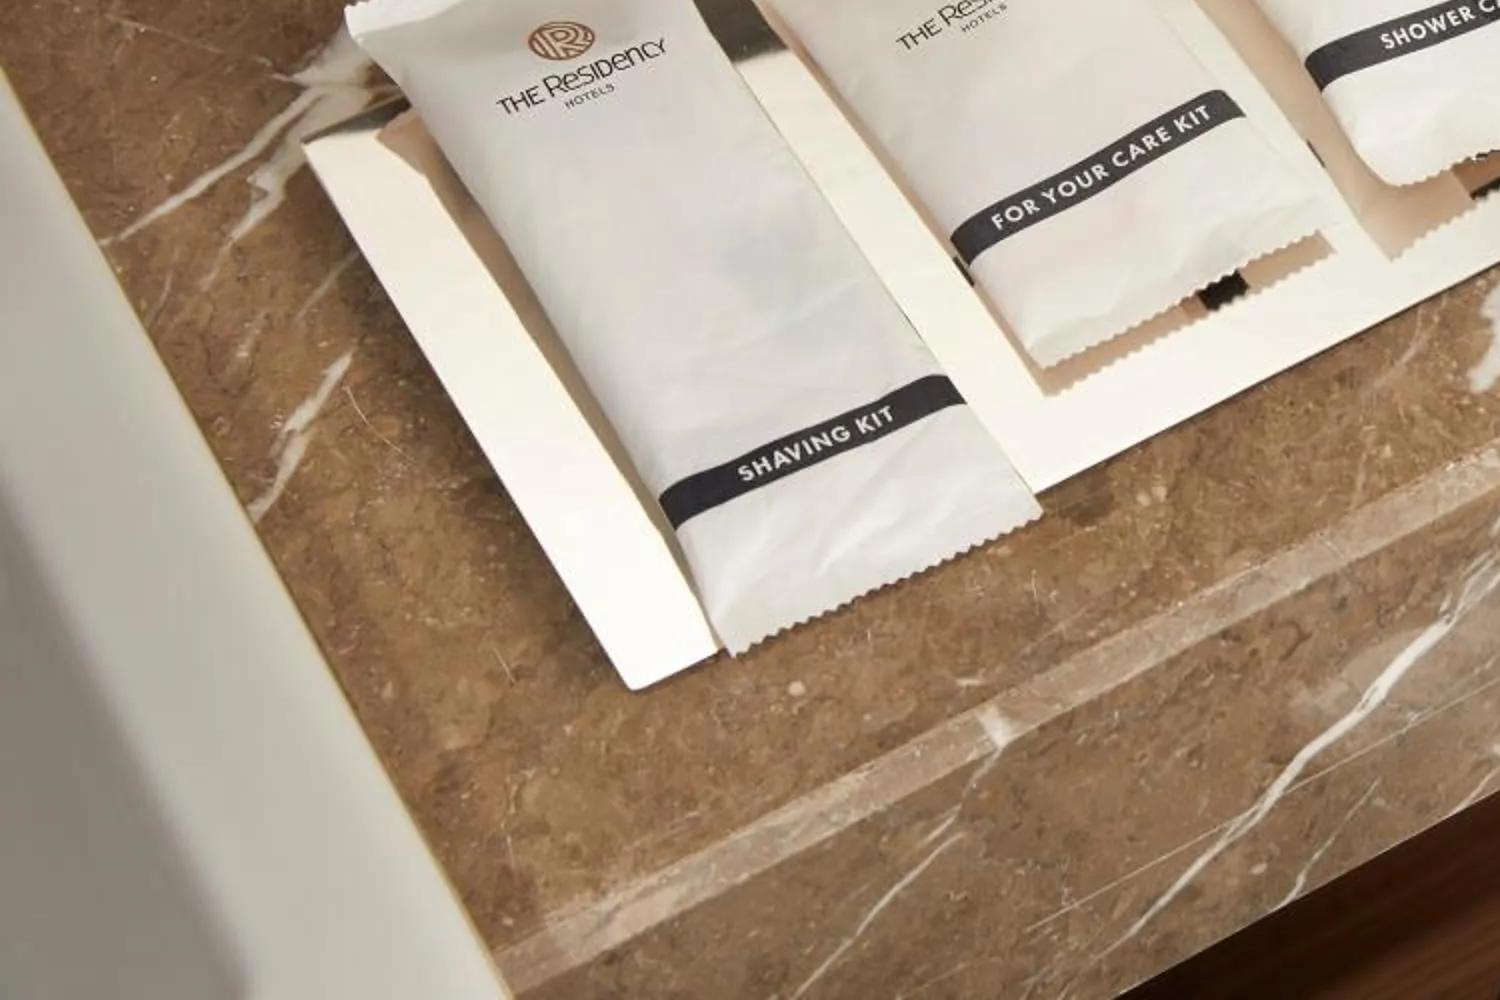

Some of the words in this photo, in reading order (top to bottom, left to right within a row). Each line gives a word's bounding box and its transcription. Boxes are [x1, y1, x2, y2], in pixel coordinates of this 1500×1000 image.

[895, 17, 943, 51] THE
[960, 3, 1008, 33] HOTELS
[1379, 5, 1476, 50] SHOWER
[495, 85, 546, 115] THE
[563, 83, 616, 110] HOTELS
[991, 198, 1041, 231] FOR
[1041, 163, 1111, 205] YOUR
[1111, 126, 1172, 168] CARE
[1173, 104, 1212, 134] KIT
[736, 425, 851, 482] SHAVING
[855, 405, 895, 435] KIT
